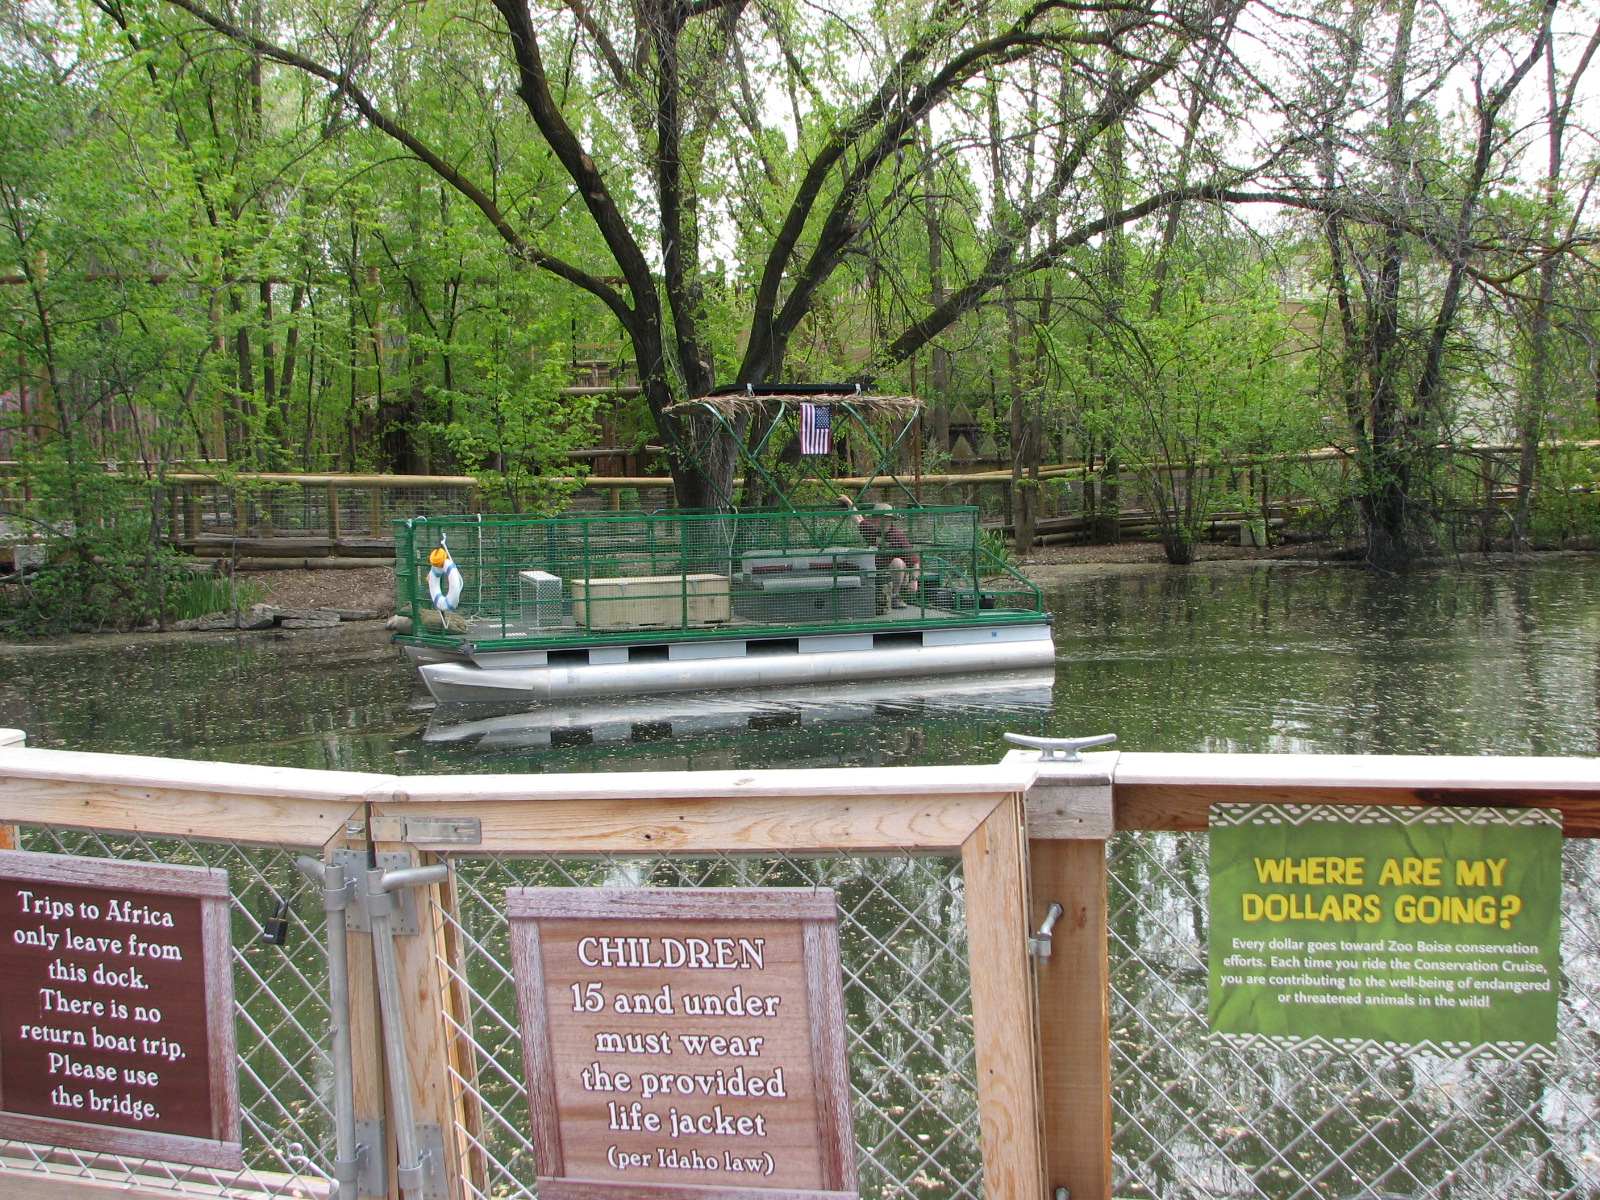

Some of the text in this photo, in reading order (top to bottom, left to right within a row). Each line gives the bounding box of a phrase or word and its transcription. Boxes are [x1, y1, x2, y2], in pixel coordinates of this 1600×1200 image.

[1254, 856, 1507, 887] WHERE ARE MY
[18, 891, 174, 928] Trips to Africa
[1242, 893, 1521, 929] DOLLARS GOING?
[13, 925, 182, 960] only leave from
[578, 937, 765, 969] CHILDREN
[1232, 938, 1538, 955] Every dollar goes toward Zoo Boise conservation
[49, 959, 149, 989] this dock.
[1223, 955, 1547, 975] efforts. Each time you ride the Conservation Cruise,
[571, 983, 780, 1016] 15 and under
[1220, 973, 1550, 993] you are contributing to the well-being of endangered
[1277, 991, 1490, 1008] or threatened animals in the wild!
[40, 988, 161, 1023] There is no
[21, 1022, 186, 1060] return boat trip.
[596, 1032, 764, 1056] must wear
[49, 1052, 159, 1086] Please use
[582, 1063, 786, 1098] the provided
[52, 1085, 160, 1121] the bridge.
[608, 1102, 766, 1137] life jacket
[607, 1146, 775, 1176] (per Idaho law)
